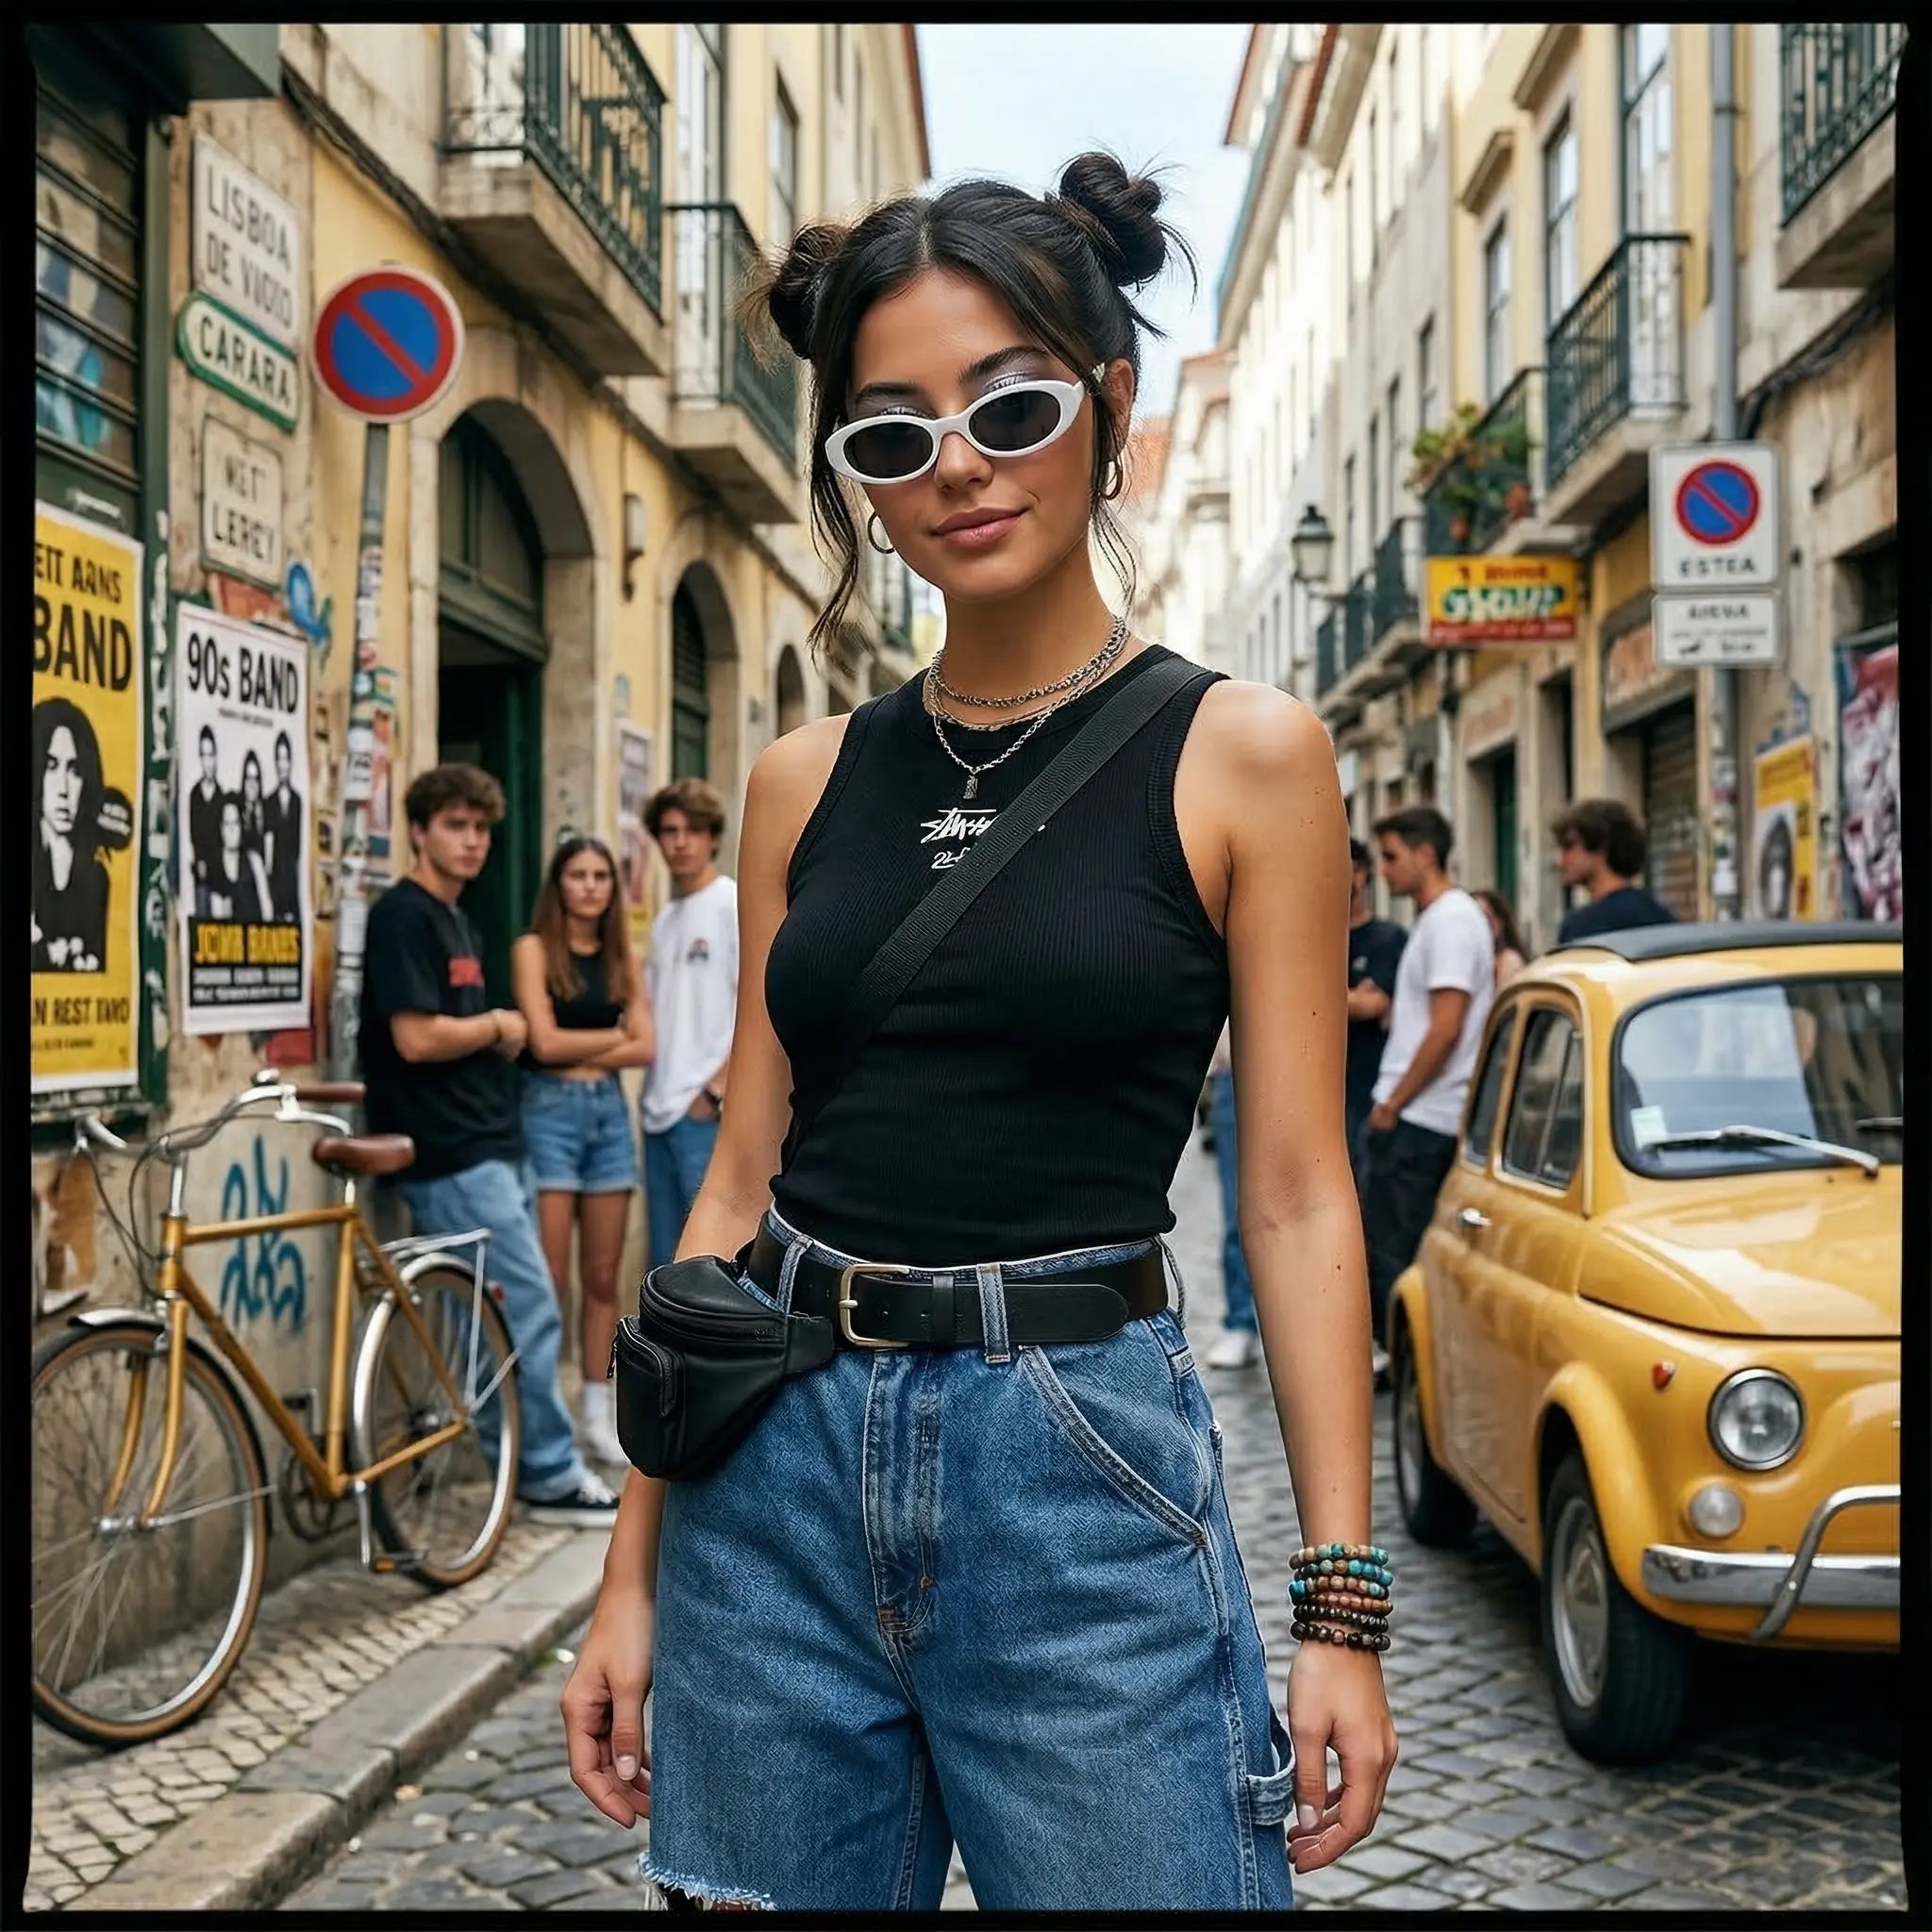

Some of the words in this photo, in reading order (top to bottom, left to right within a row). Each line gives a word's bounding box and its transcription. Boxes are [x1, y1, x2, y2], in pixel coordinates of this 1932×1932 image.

[207, 164, 291, 274] LISBOA
[207, 231, 232, 287] DE
[199, 315, 291, 408] CARARA
[33, 593, 132, 692] BAND
[188, 632, 230, 700] 90s
[240, 647, 299, 714] BAND
